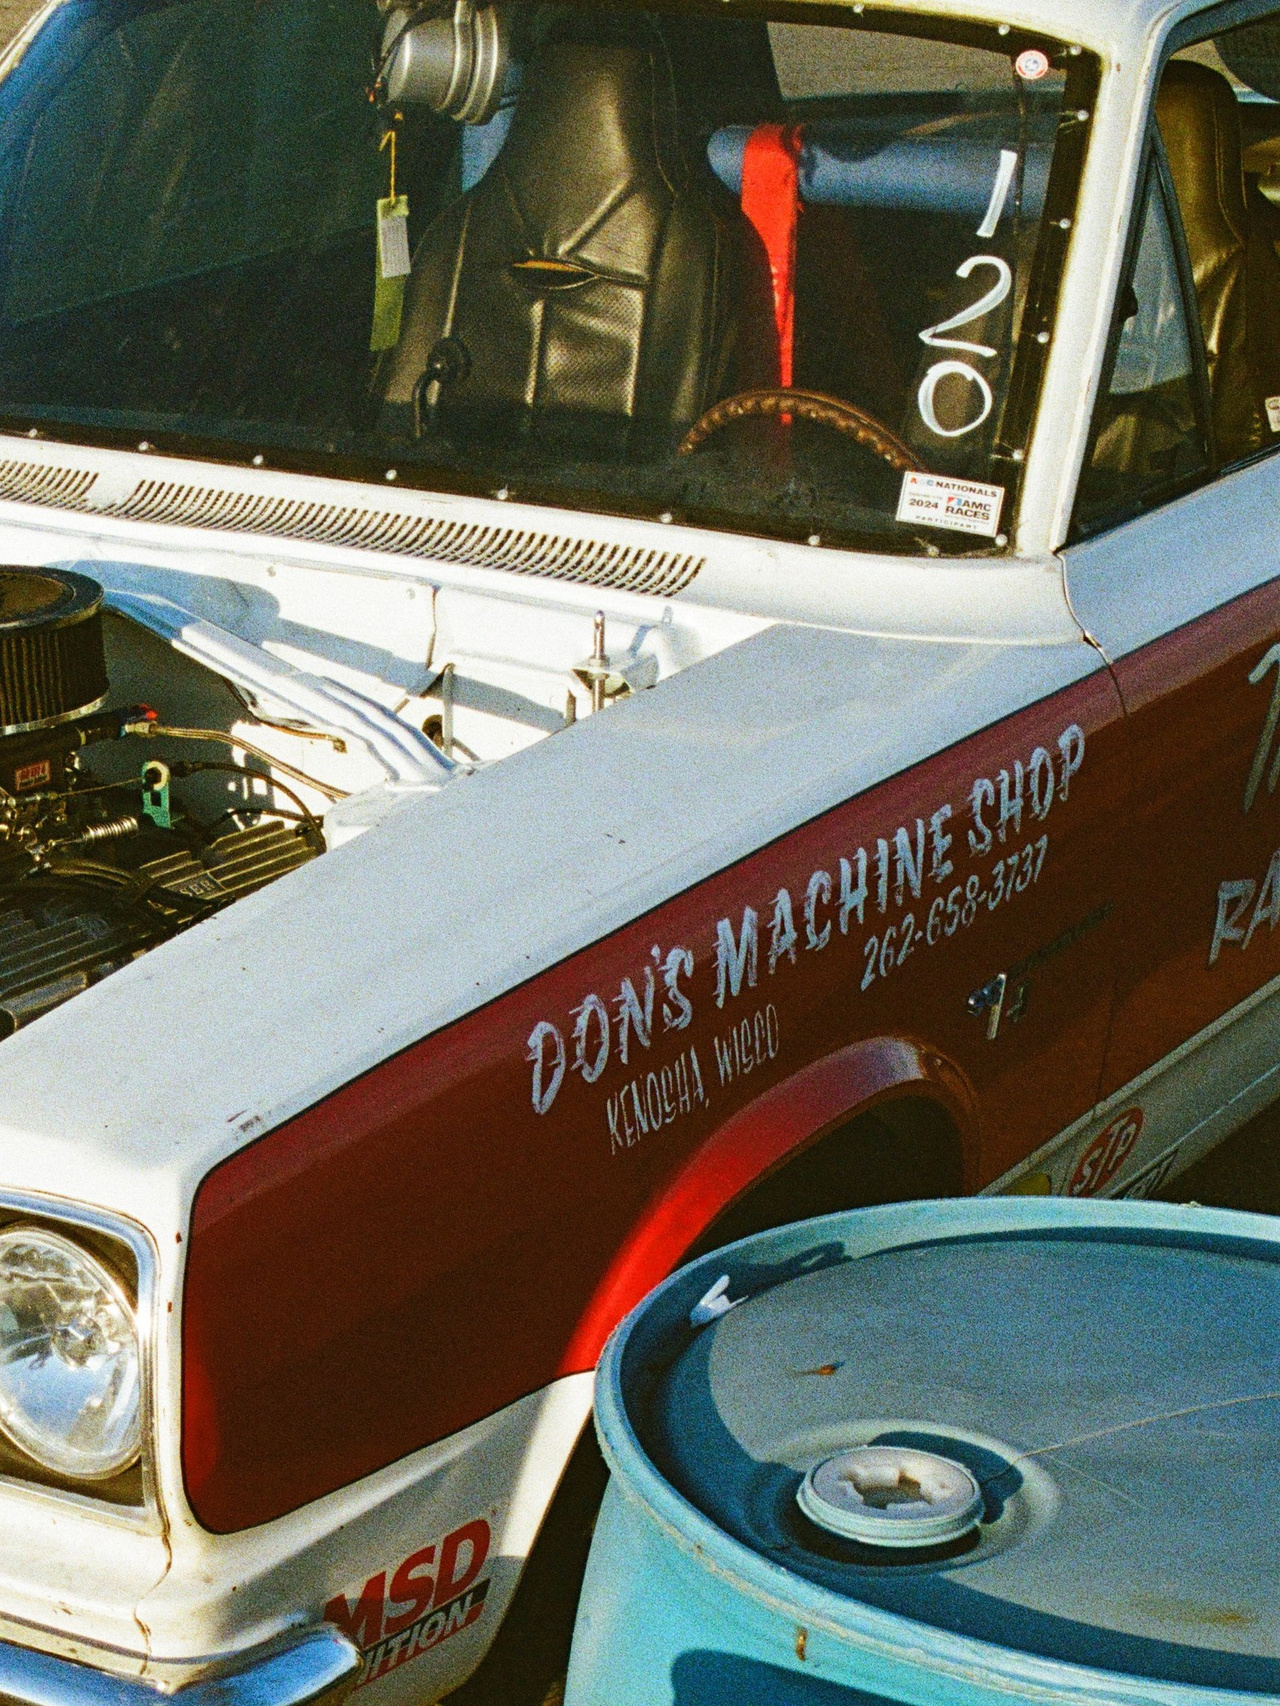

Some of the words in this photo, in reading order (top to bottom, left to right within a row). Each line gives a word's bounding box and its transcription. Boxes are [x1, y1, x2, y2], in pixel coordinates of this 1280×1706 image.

[908, 498, 939, 510] 2024
[909, 477, 934, 487] AC
[935, 481, 997, 498] NATIONALS
[944, 505, 990, 521] RACES
[962, 500, 992, 512] AMC
[525, 943, 695, 1116] DON'S
[711, 803, 953, 1010] MACHINE
[968, 723, 1085, 858] SHOP
[860, 833, 1049, 992] 262-658-3737
[714, 1003, 780, 1087] WISCO
[1072, 1113, 1138, 1197] STP
[323, 1517, 491, 1651] MSD
[357, 1591, 473, 1690] ITION
